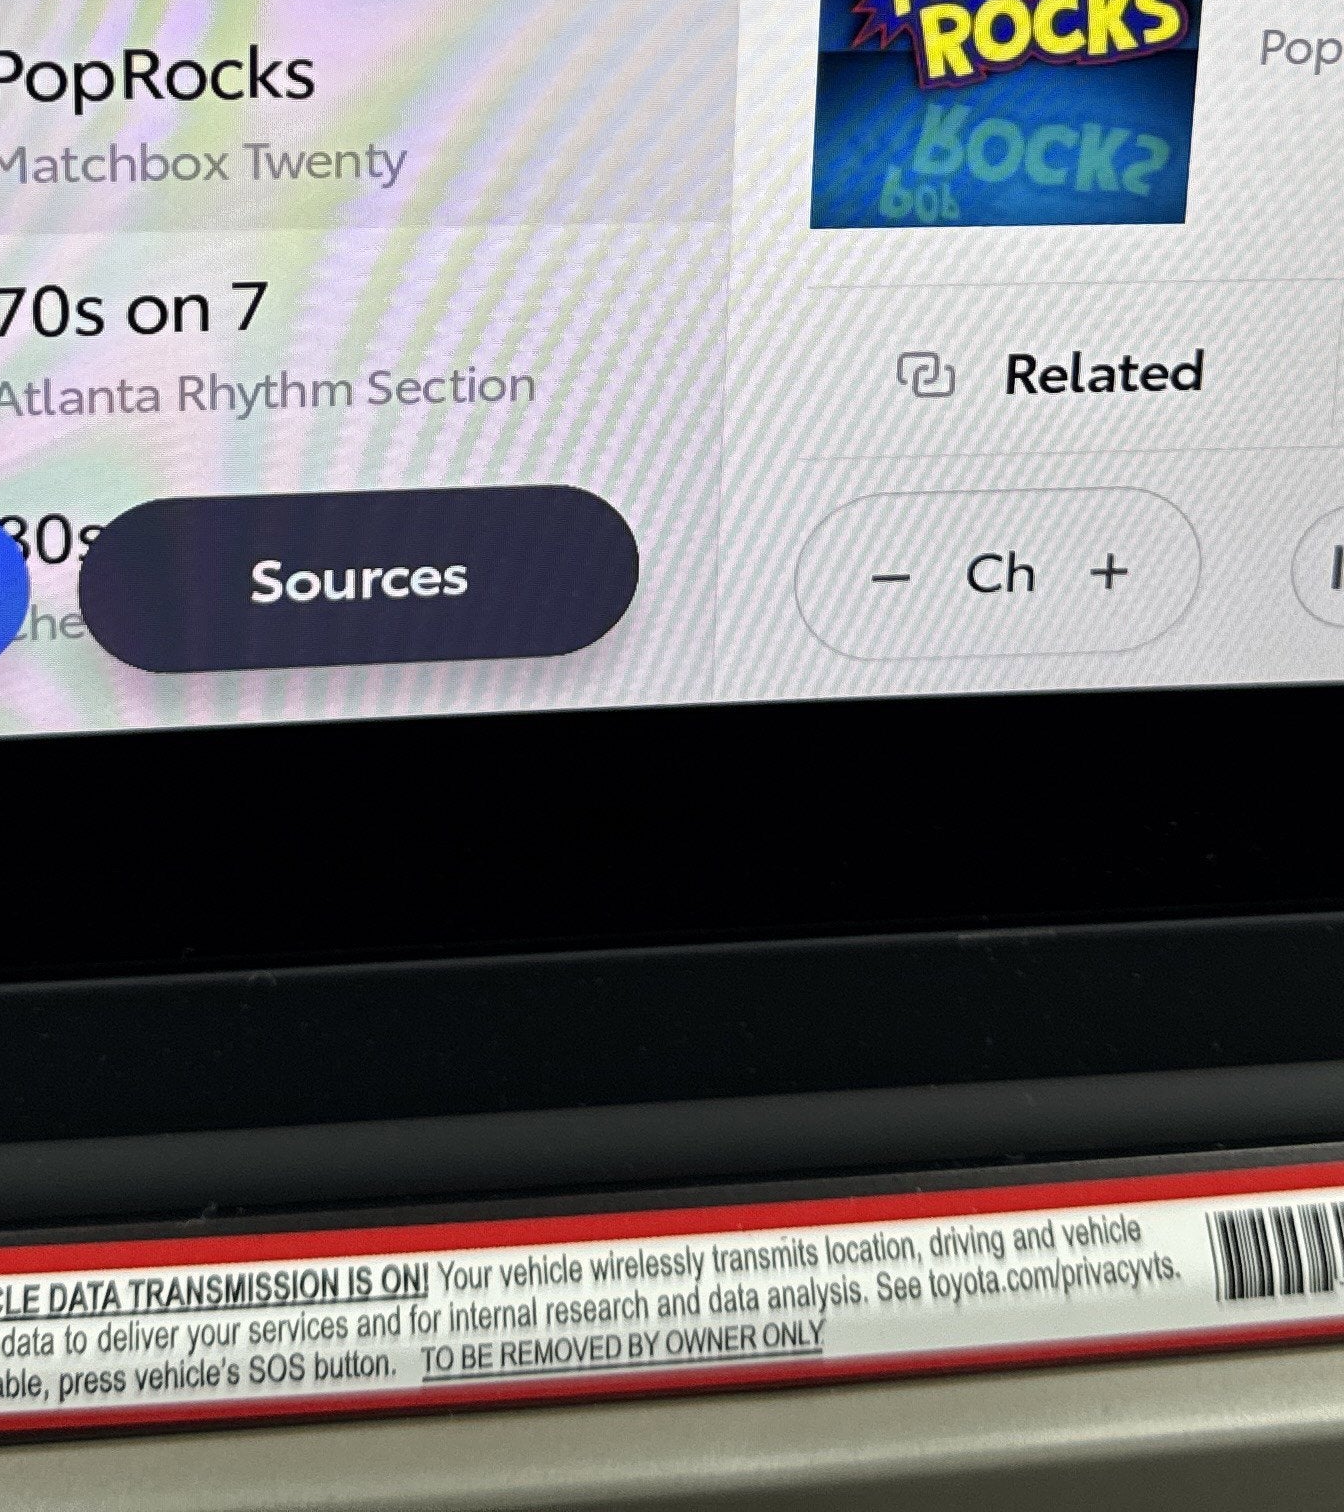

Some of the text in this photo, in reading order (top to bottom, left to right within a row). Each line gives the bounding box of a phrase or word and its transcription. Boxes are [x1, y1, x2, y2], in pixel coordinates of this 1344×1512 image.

[244, 142, 407, 189] Twenty
[127, 292, 210, 334] on
[232, 281, 269, 331] 7
[178, 374, 353, 420] Rhythm
[369, 368, 535, 406] Section
[1005, 349, 1206, 395] Related
[251, 558, 468, 603] Sources
[967, 550, 1035, 594] Ch
[13, 604, 86, 640] he
[50, 1279, 122, 1314] DATA
[128, 1268, 342, 1311] TRANSMISSION
[348, 1266, 371, 1298] IS
[381, 1262, 429, 1296] ON!
[438, 1259, 492, 1291] Your
[499, 1249, 582, 1287] vehicle
[590, 1244, 705, 1285] wirelessly
[713, 1236, 819, 1275] transmits
[825, 1232, 923, 1267] location,
[929, 1225, 1005, 1259] driving
[1013, 1219, 1055, 1251] and
[1062, 1213, 1141, 1247] vehicle
[1, 1323, 54, 1357] data
[65, 1323, 88, 1355] to
[97, 1316, 179, 1352] deliver
[186, 1319, 242, 1355] your
[248, 1310, 348, 1347] services
[357, 1302, 401, 1338] and
[409, 1300, 443, 1334] for
[449, 1294, 537, 1331] internal
[546, 1287, 649, 1325] research
[657, 1282, 699, 1318] and
[708, 1278, 759, 1314] data
[767, 1272, 868, 1313] analysis.
[876, 1267, 922, 1299] See
[928, 1250, 1181, 1303] toyota.com/privacyvts.
[58, 1369, 126, 1404] press
[133, 1357, 241, 1396] vehicle's
[248, 1352, 305, 1383] SOS
[312, 1347, 397, 1380] button.
[422, 1345, 455, 1373] TO
[461, 1342, 493, 1370] BE
[500, 1337, 622, 1368] REMOVED
[627, 1331, 660, 1358] BY
[666, 1324, 757, 1357] OWNER
[762, 1319, 824, 1349] ONLY
